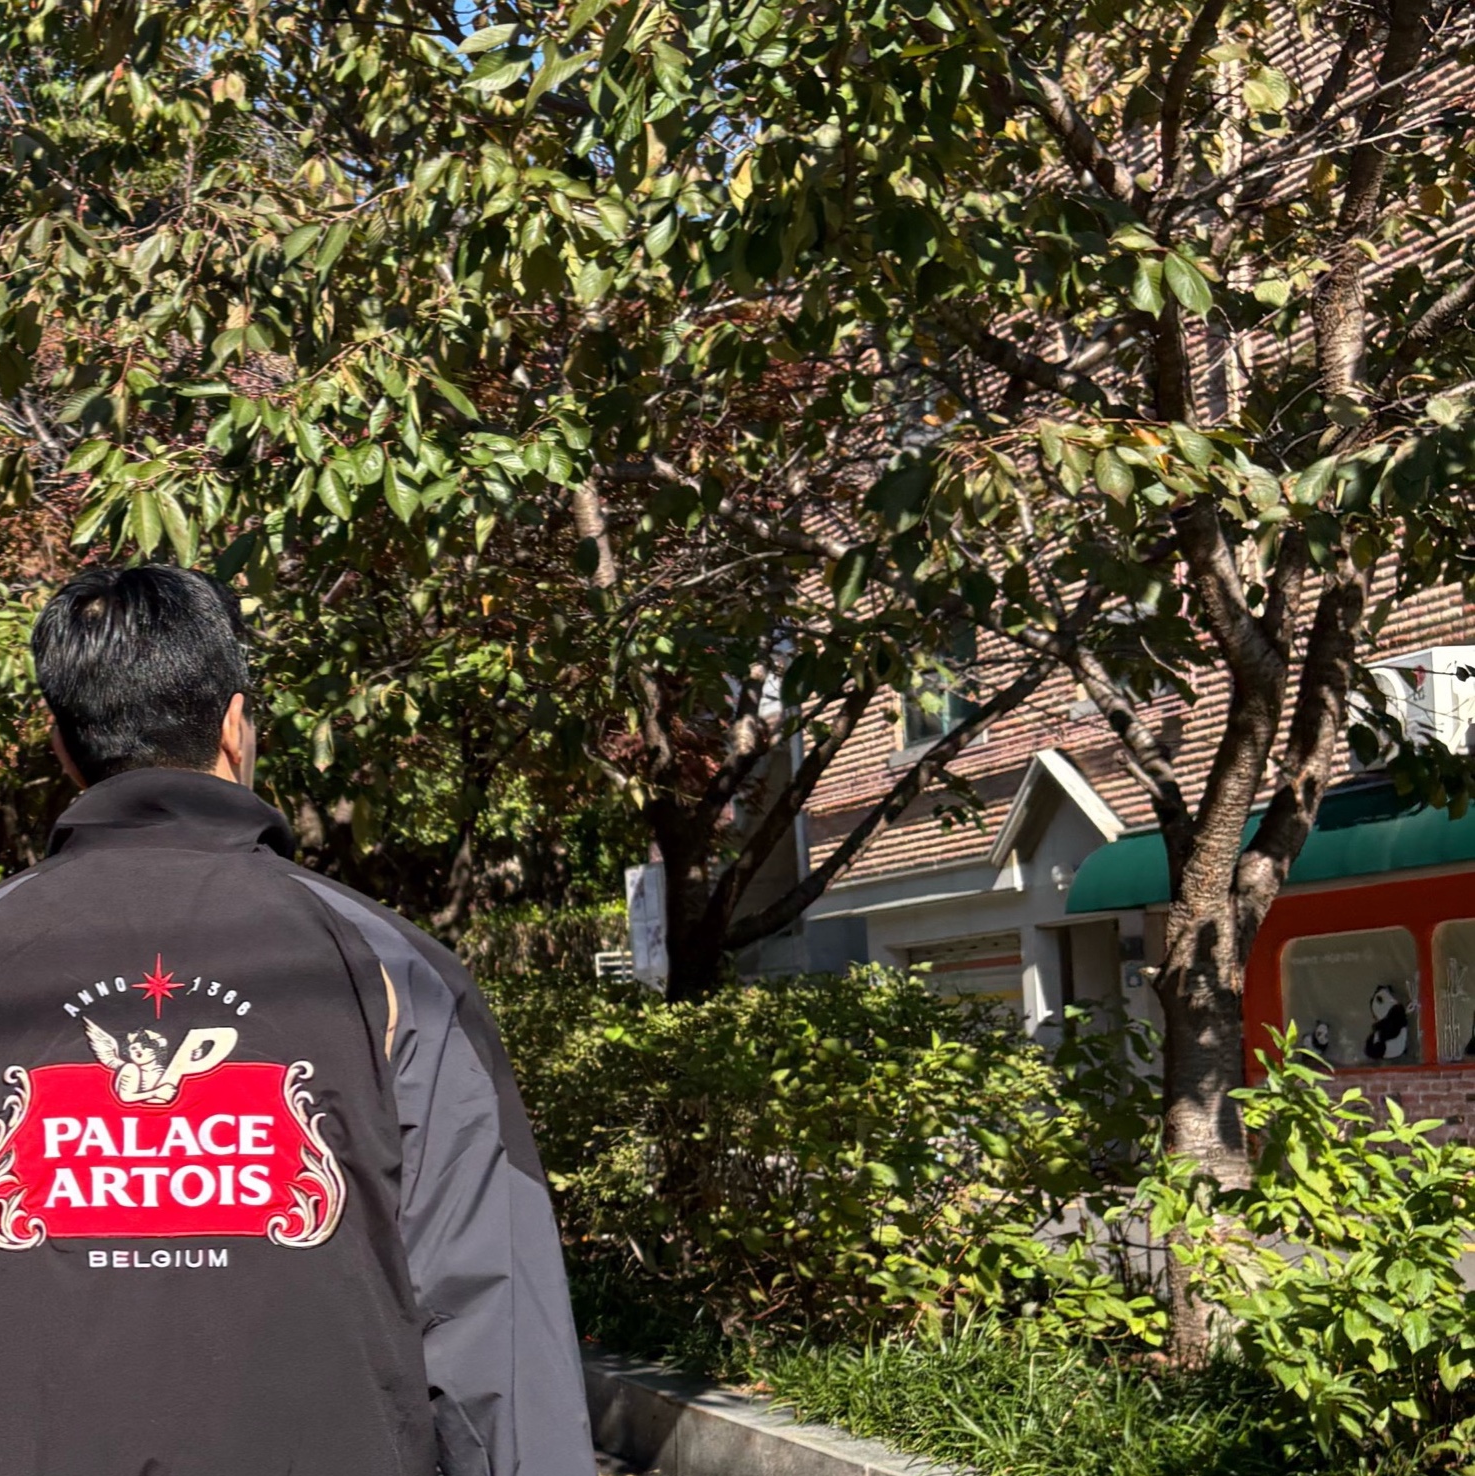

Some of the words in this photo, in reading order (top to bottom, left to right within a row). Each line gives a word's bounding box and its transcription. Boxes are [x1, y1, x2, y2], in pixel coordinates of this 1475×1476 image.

[63, 976, 127, 1018] ANNO
[189, 976, 252, 1016] 1366
[155, 1026, 239, 1088] P
[42, 1114, 275, 1159] PALACE
[43, 1164, 272, 1208] ARTOIS
[88, 1249, 228, 1268] BELGIUM
